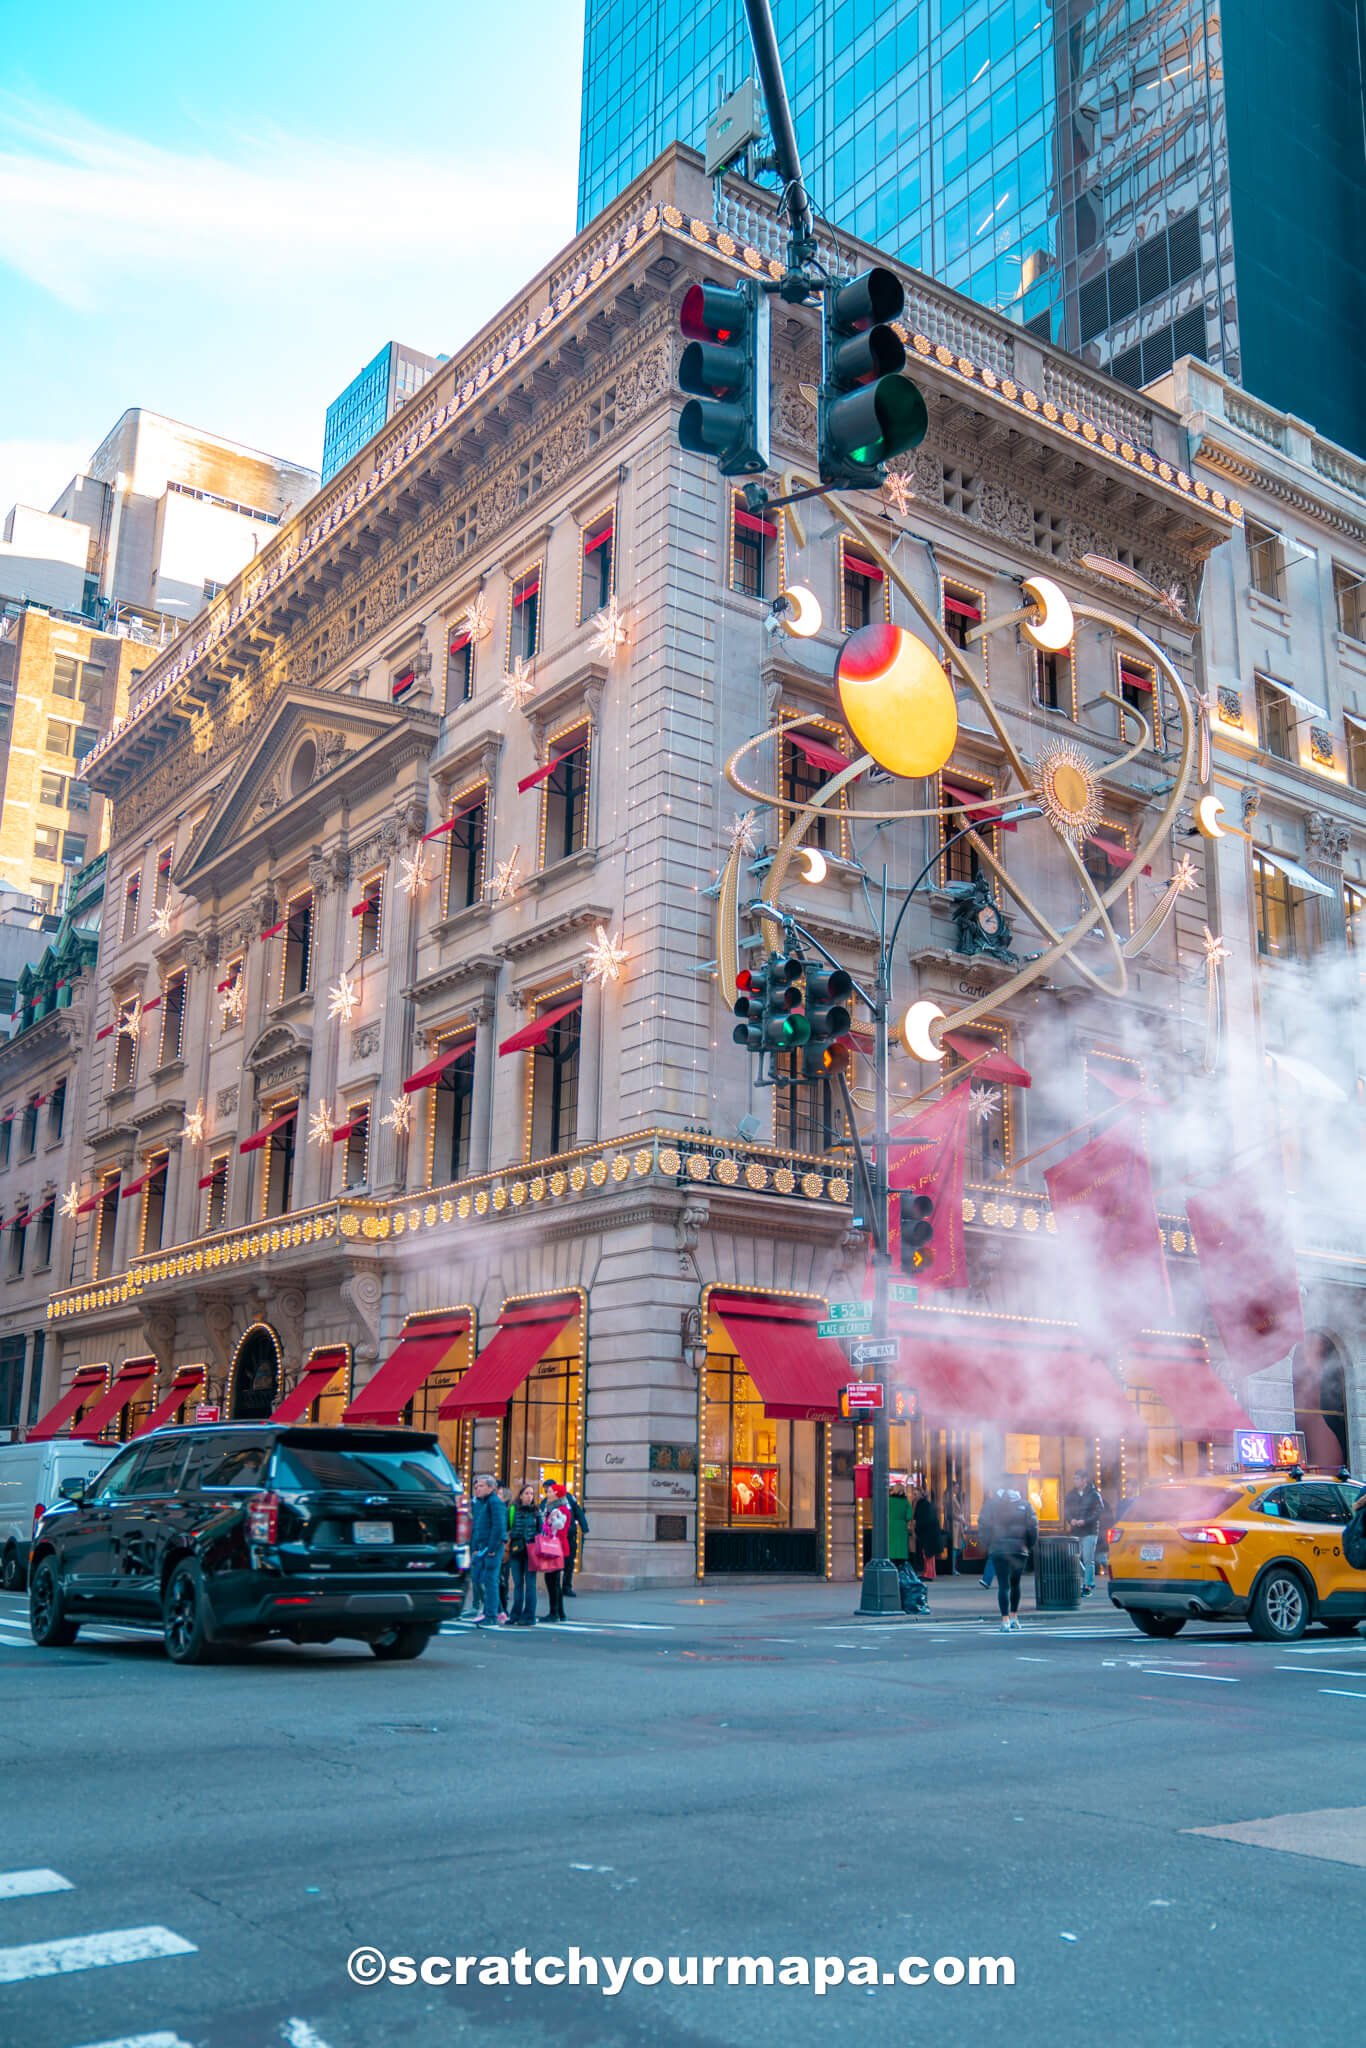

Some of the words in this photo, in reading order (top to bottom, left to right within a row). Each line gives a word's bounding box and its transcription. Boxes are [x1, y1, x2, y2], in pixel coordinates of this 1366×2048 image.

[830, 1305, 837, 1318] E
[841, 1303, 856, 1317] 52
[820, 1324, 837, 1334] PLACE
[847, 1322, 870, 1333] CARTIER
[857, 1348, 870, 1358] ONE
[877, 1345, 891, 1355] WAY
[538, 1363, 557, 1374] Cartier
[435, 1376, 451, 1385] Cartier
[806, 1408, 837, 1421] Cartier
[605, 1453, 624, 1464] Cartier
